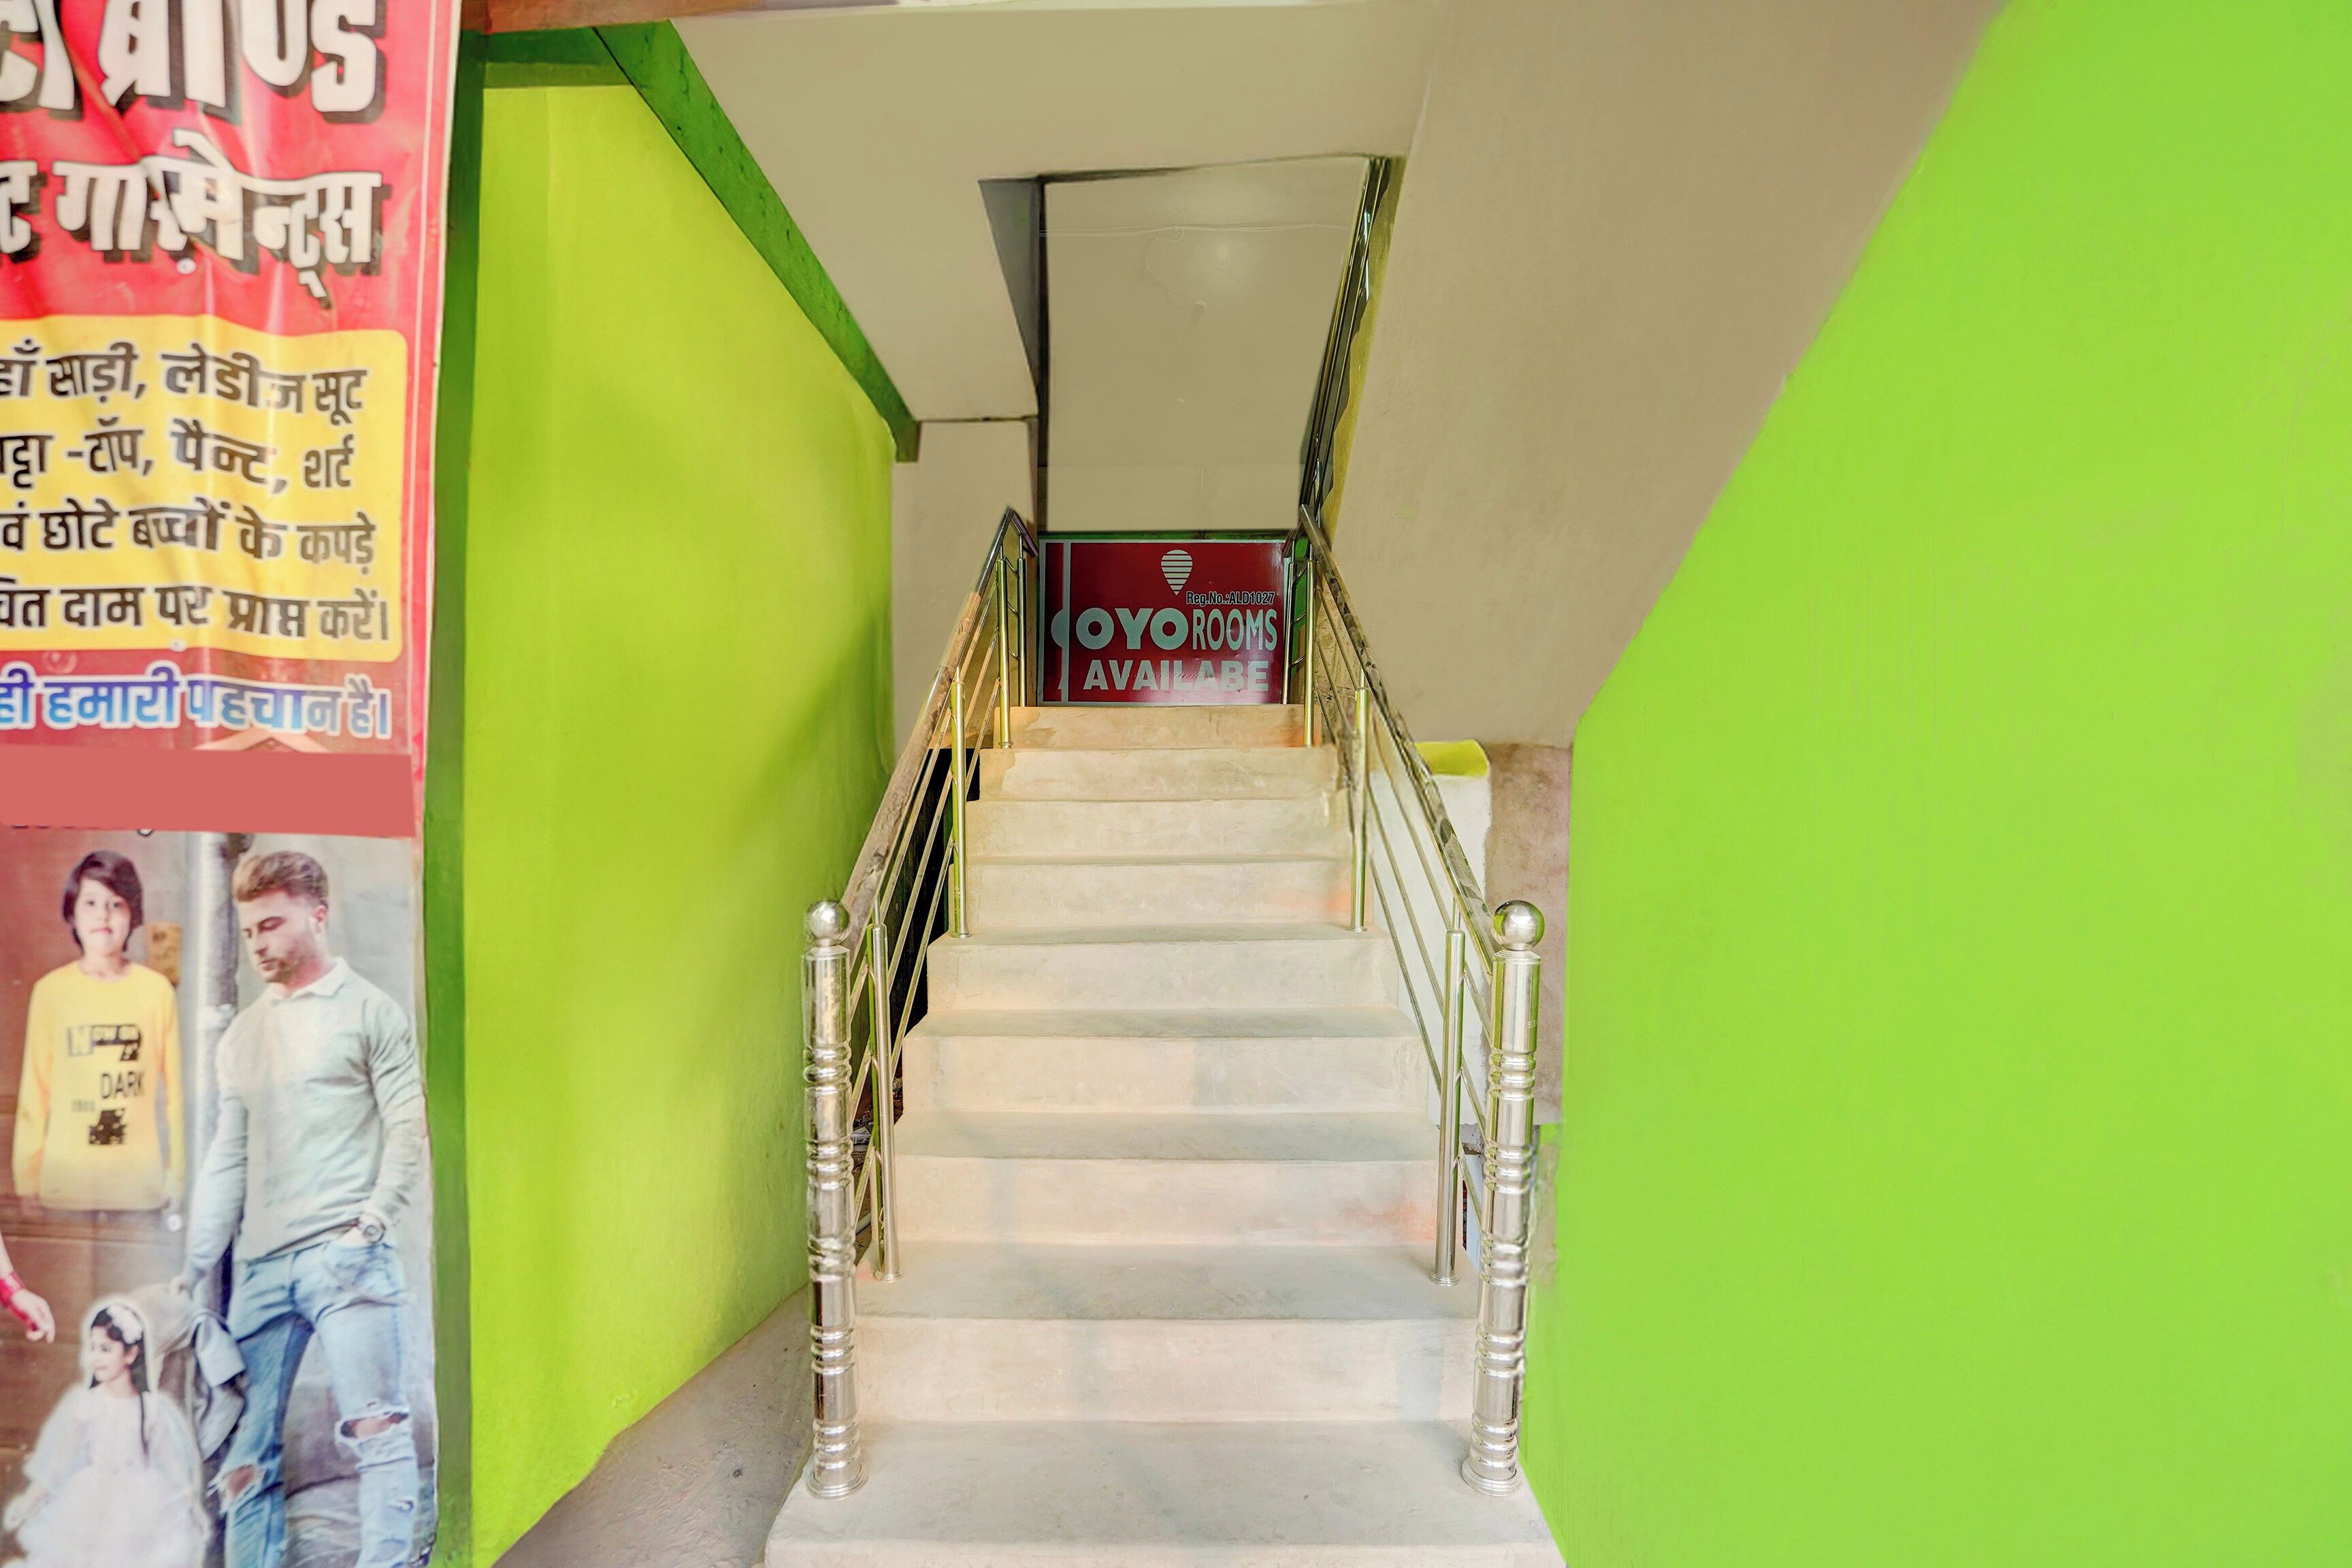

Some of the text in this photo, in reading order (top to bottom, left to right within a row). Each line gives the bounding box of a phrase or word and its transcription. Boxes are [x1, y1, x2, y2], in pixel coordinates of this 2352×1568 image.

[46, 342, 146, 403] साड़ी,
[161, 342, 306, 414] लेडीज
[312, 370, 368, 425] सूट
[304, 434, 354, 488] शर्ट
[39, 497, 120, 550] छोटे
[128, 497, 231, 551] बच्चों
[235, 505, 289, 559] के
[297, 511, 376, 575] कपड़े
[60, 587, 146, 627] दाम
[154, 585, 214, 625] पर
[222, 590, 311, 638] प्राप्त
[1075, 607, 1278, 651] OYO ROOMS
[44, 666, 180, 724] हमारी
[187, 679, 343, 732] पहचान
[1083, 659, 1269, 691] AVAILABE
